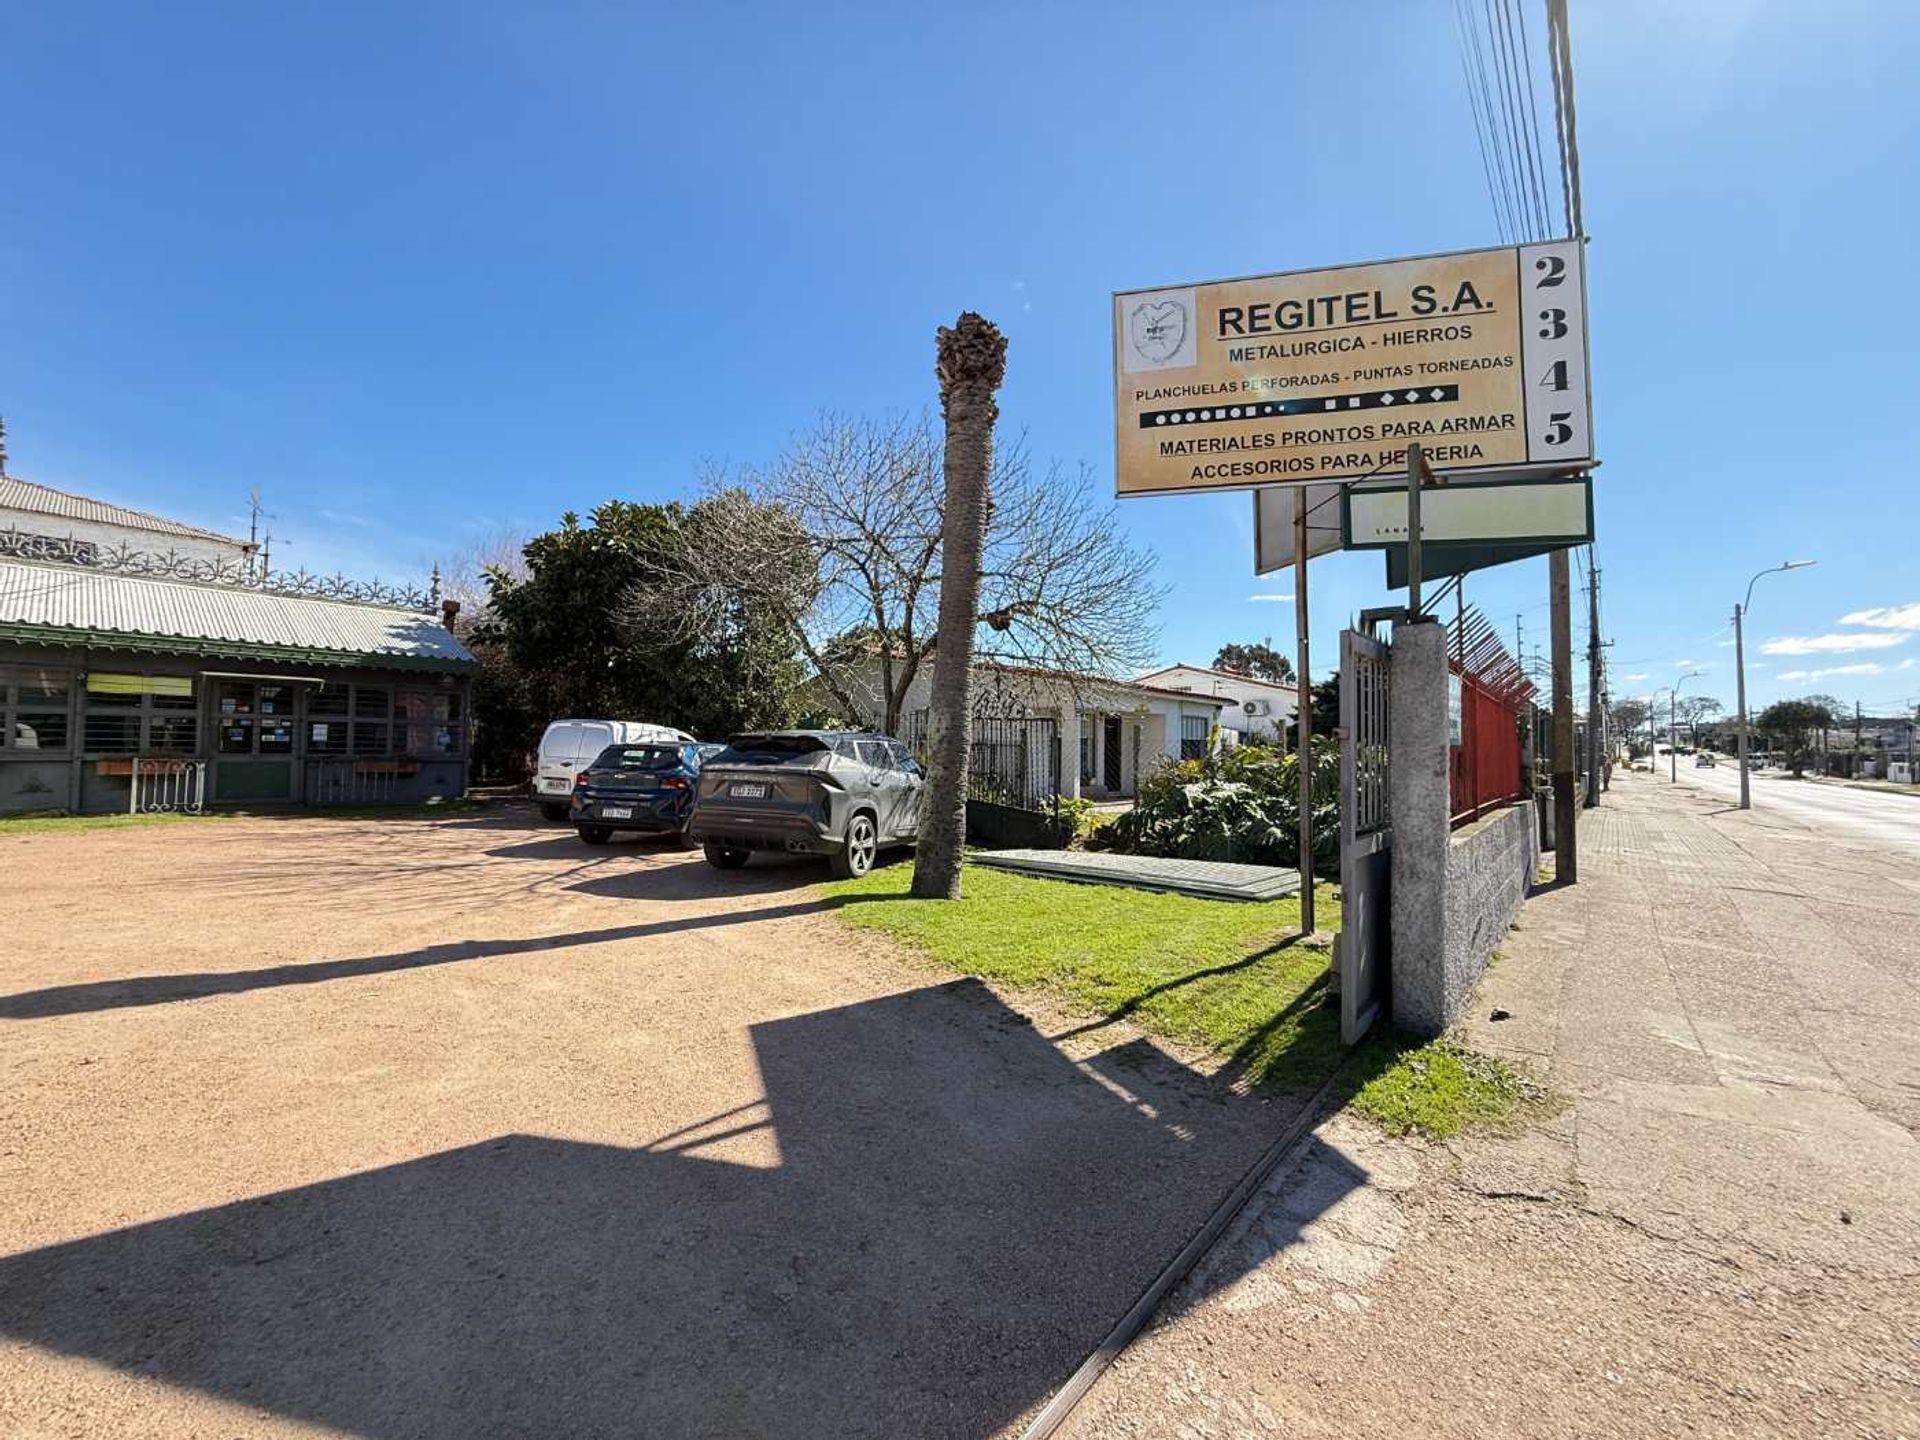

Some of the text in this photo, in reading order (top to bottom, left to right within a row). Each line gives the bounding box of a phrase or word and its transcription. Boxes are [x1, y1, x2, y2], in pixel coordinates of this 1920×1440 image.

[1219, 281, 1494, 336] REGITEL S.A.
[1230, 336, 1365, 362] METALURGICA
[1383, 325, 1472, 346] HIERROS
[1136, 382, 1238, 401] PLANCHUELAS
[1242, 373, 1340, 391] PERFORADAS
[1353, 365, 1413, 381] PUNTAS
[1418, 356, 1514, 374] TORNEADAS
[1160, 414, 1516, 455] MATERIALES PRONTOS PARA ARMAR
[1191, 444, 1484, 480] ACCESORIOS PARA HERERIA
